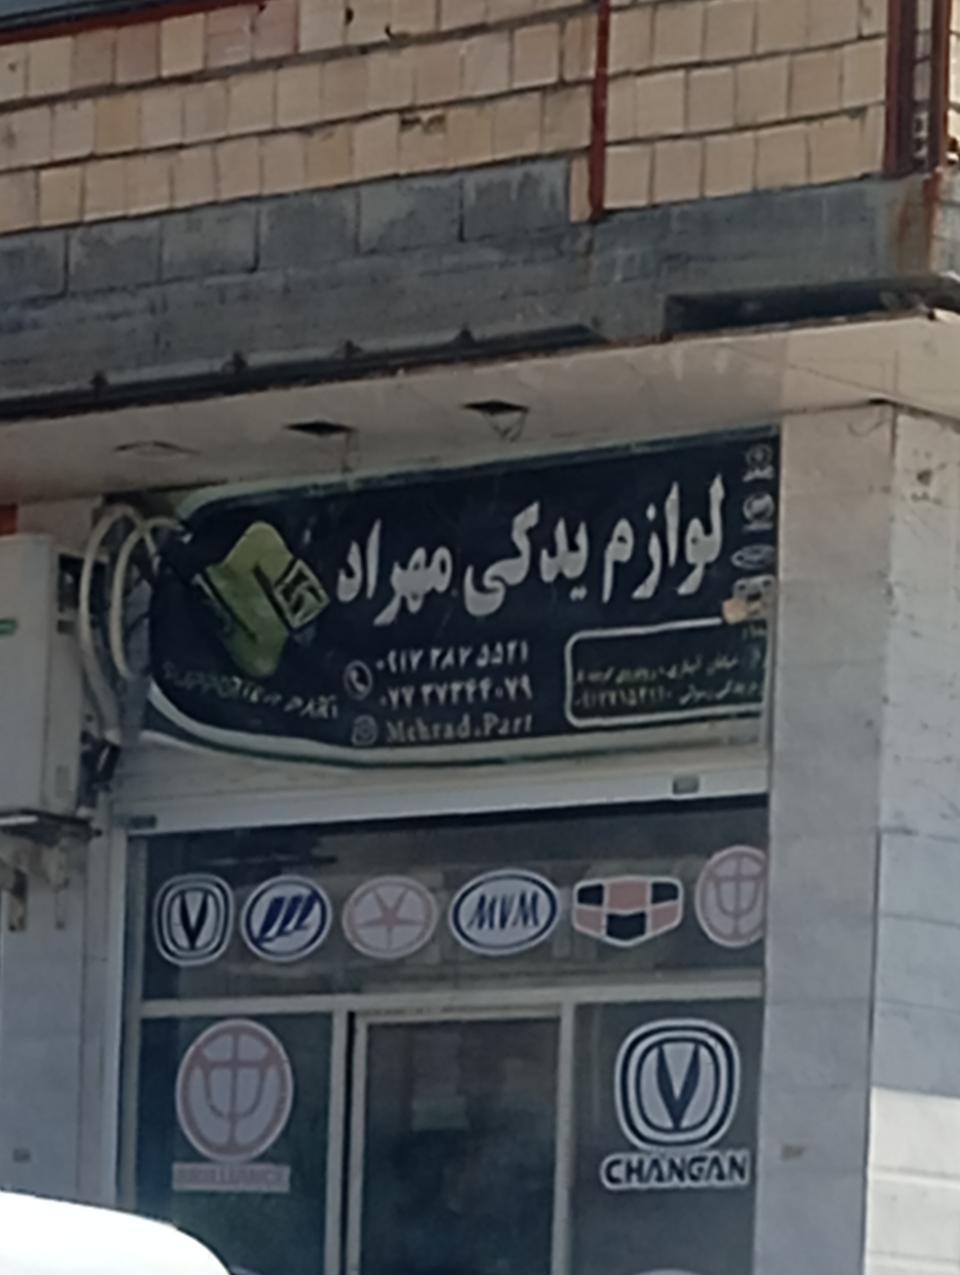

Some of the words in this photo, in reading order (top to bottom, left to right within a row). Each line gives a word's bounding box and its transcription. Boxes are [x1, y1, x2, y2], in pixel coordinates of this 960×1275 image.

[337, 518, 454, 626] مهراد
[463, 500, 588, 617] یدکی
[602, 474, 726, 602] لوازم
[466, 891, 540, 931] MVM
[603, 1154, 748, 1188] CHANGAN
